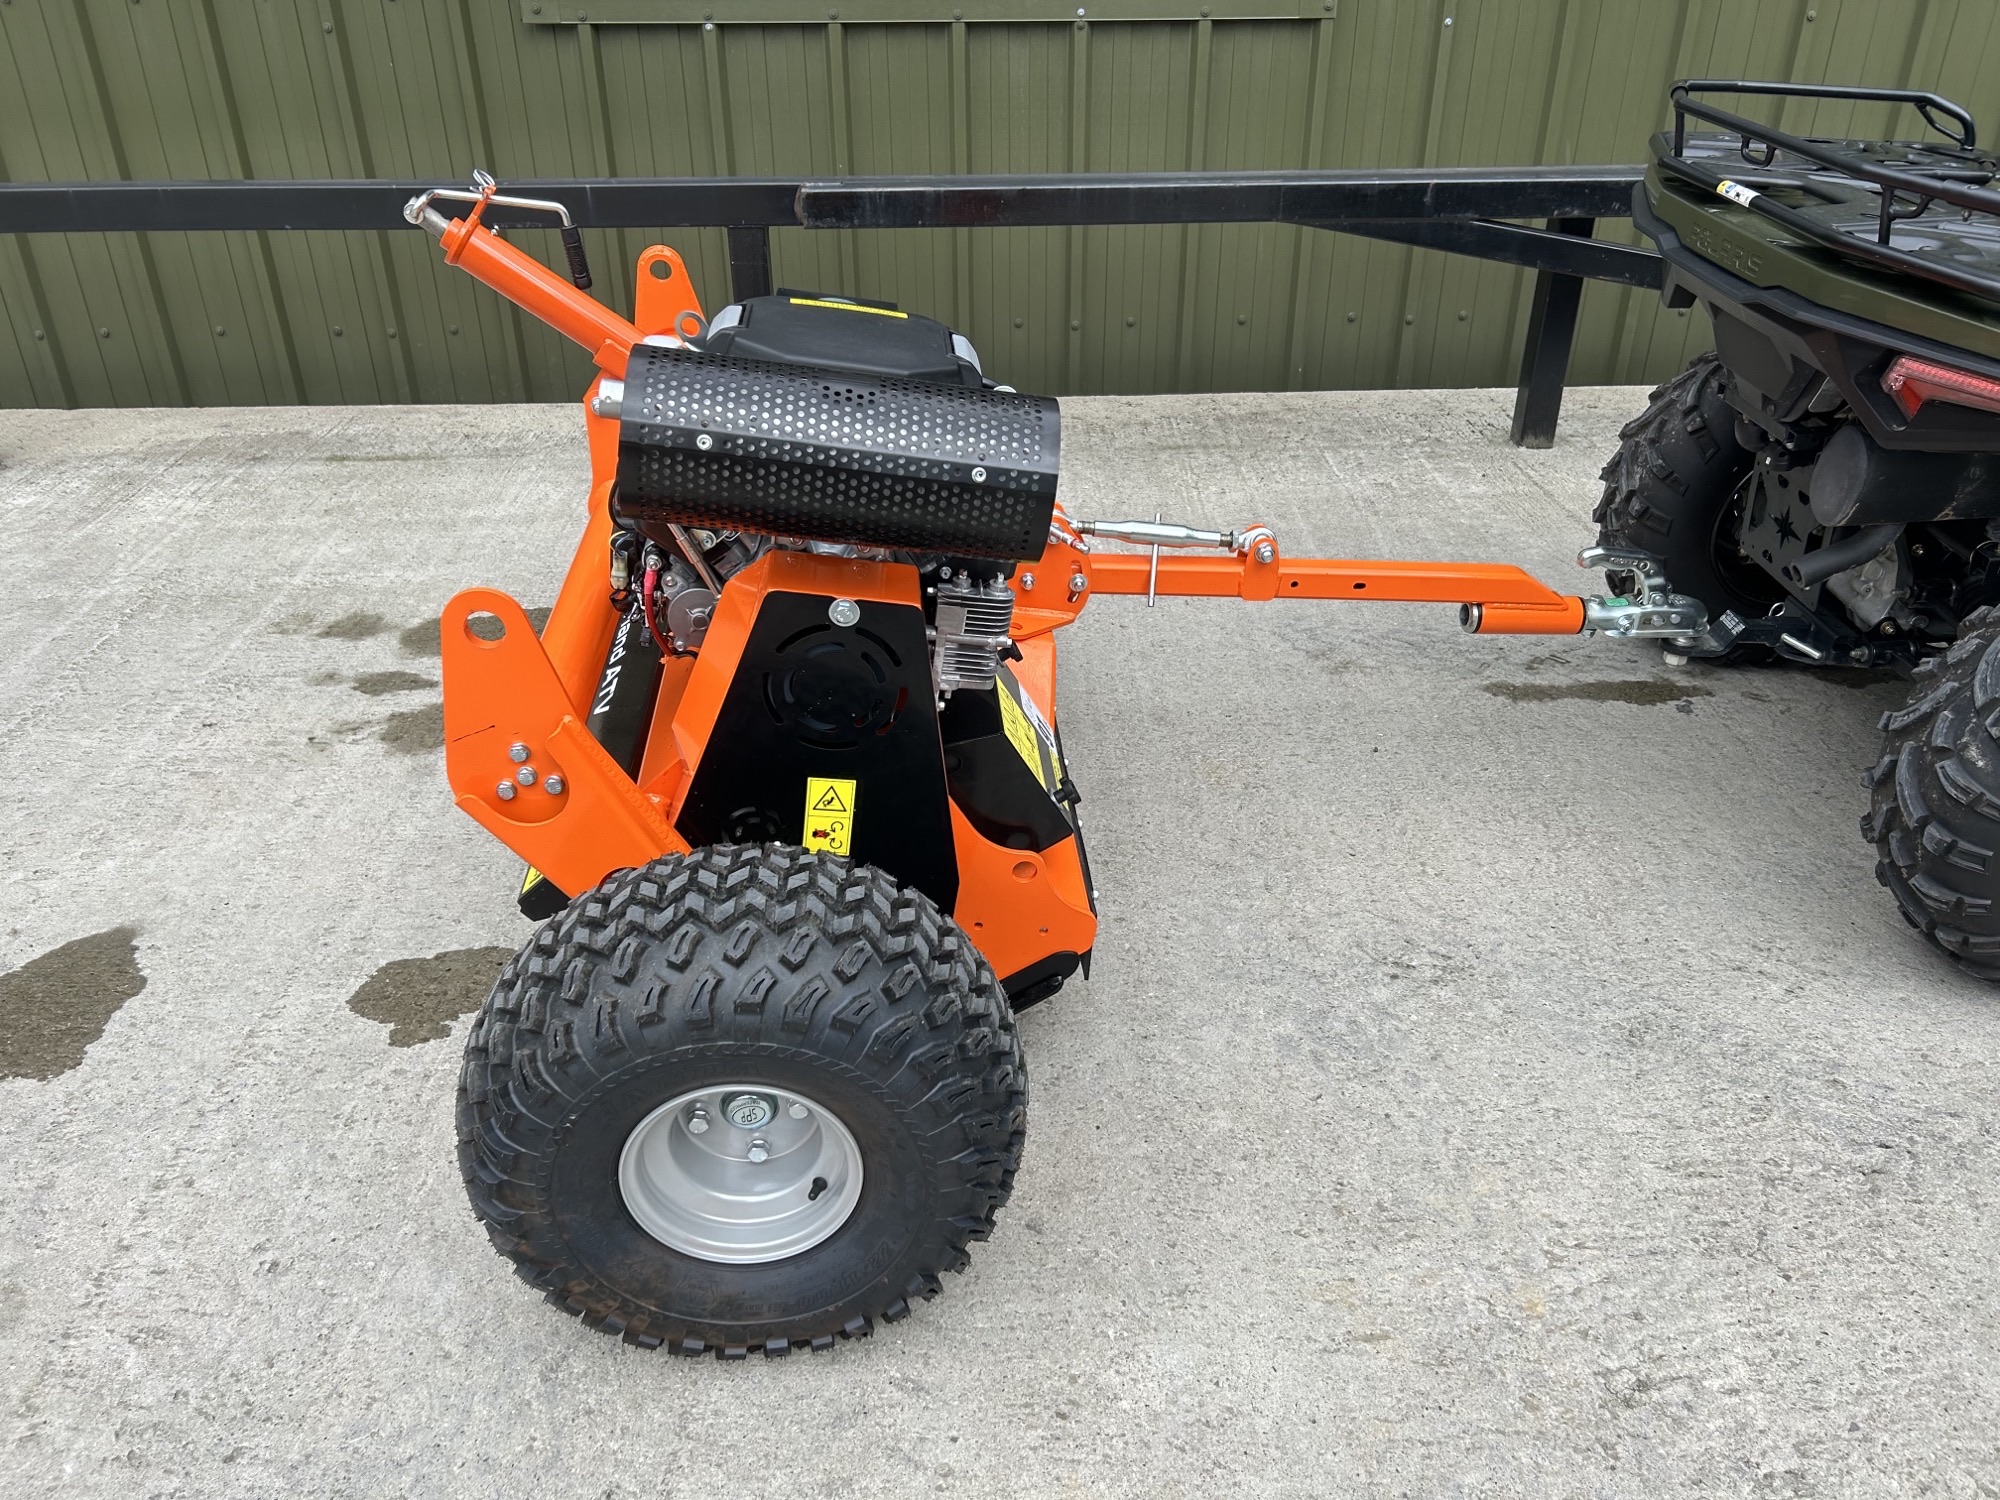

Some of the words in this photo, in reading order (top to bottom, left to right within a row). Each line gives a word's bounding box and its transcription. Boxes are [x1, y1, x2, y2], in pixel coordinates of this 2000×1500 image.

[1686, 223, 1764, 278] POLARIS
[594, 665, 622, 715] ATV
[740, 1108, 758, 1123] SPP
